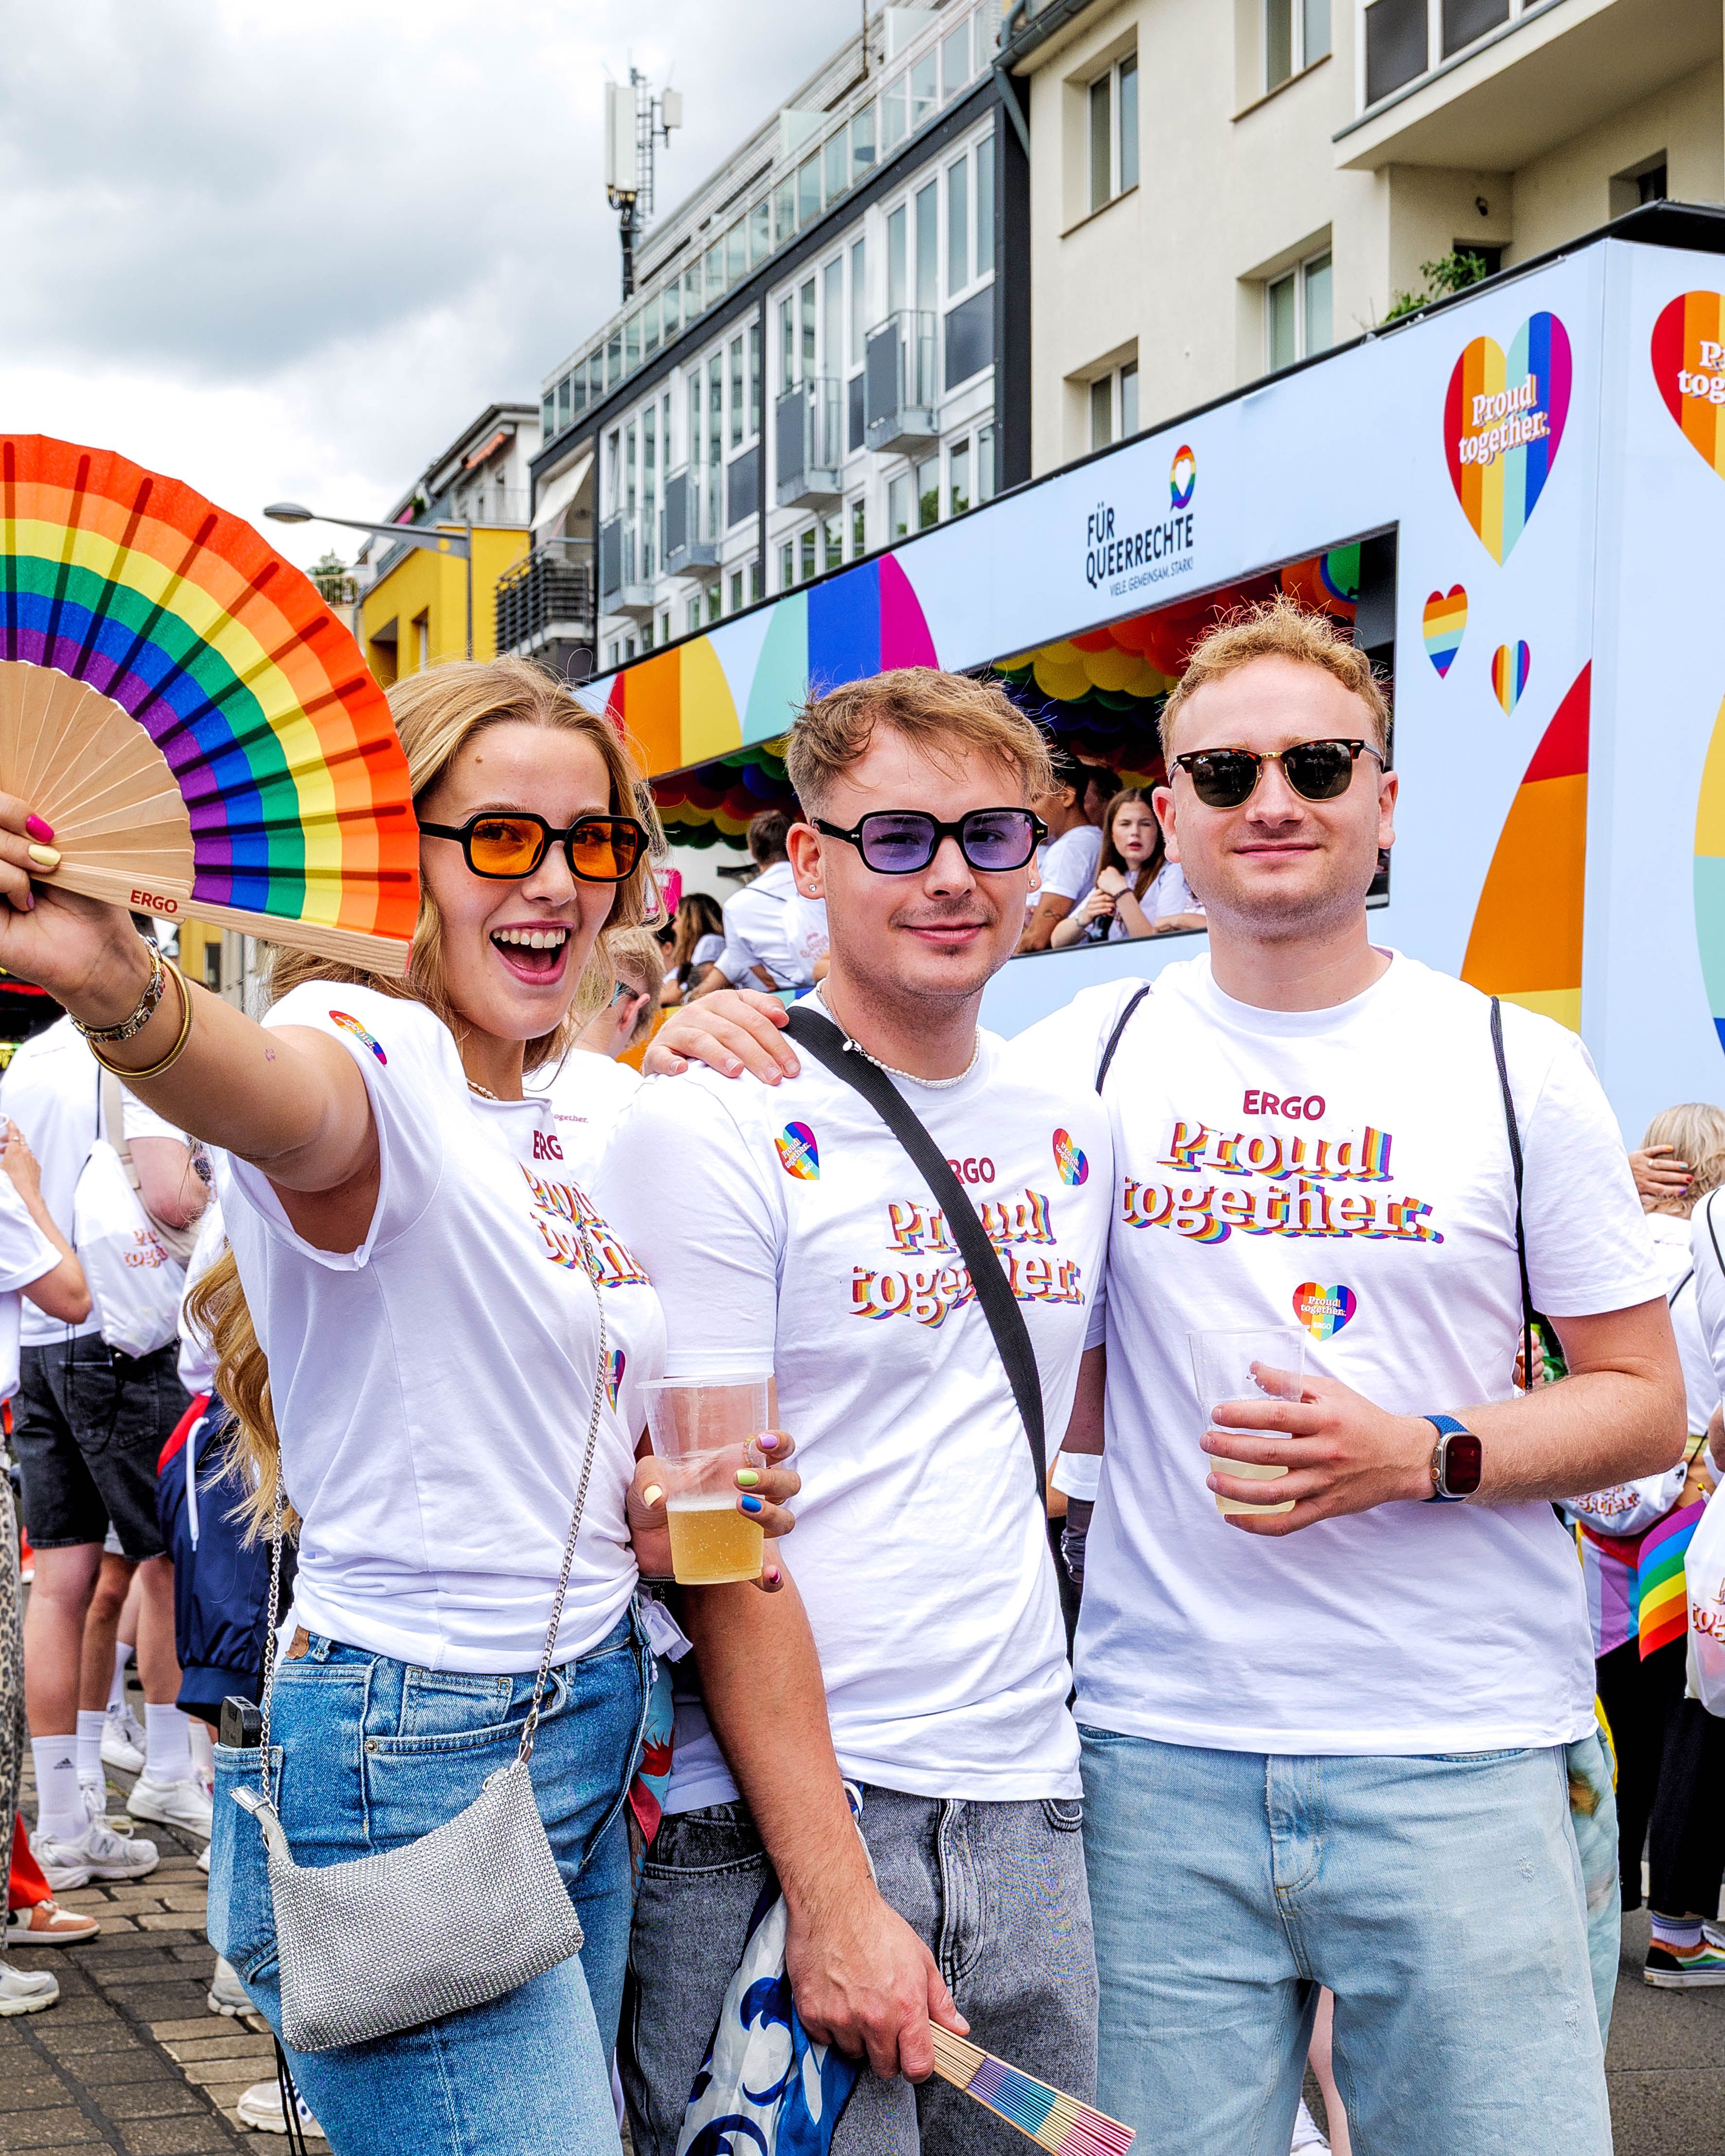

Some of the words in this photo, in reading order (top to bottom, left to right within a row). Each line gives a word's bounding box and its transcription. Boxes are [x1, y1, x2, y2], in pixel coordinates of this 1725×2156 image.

[1471, 373, 1538, 428] Proud
[1676, 369, 1725, 407] tog
[1459, 411, 1551, 466] together.
[1087, 501, 1115, 547] FÜR
[1086, 514, 1194, 590] QUEERRECHTE
[130, 889, 178, 913] ERGO
[553, 1113, 589, 1123] ogether.
[1243, 1089, 1325, 1120] ERGO
[781, 1137, 802, 1159] Proud
[1155, 1118, 1394, 1182] Proud
[946, 1157, 995, 1184] RGO
[1118, 1175, 1444, 1244] together.
[1300, 1304, 1346, 1316] together.
[1308, 1296, 1341, 1307] Proud
[1313, 1322, 1332, 1330] ERGO
